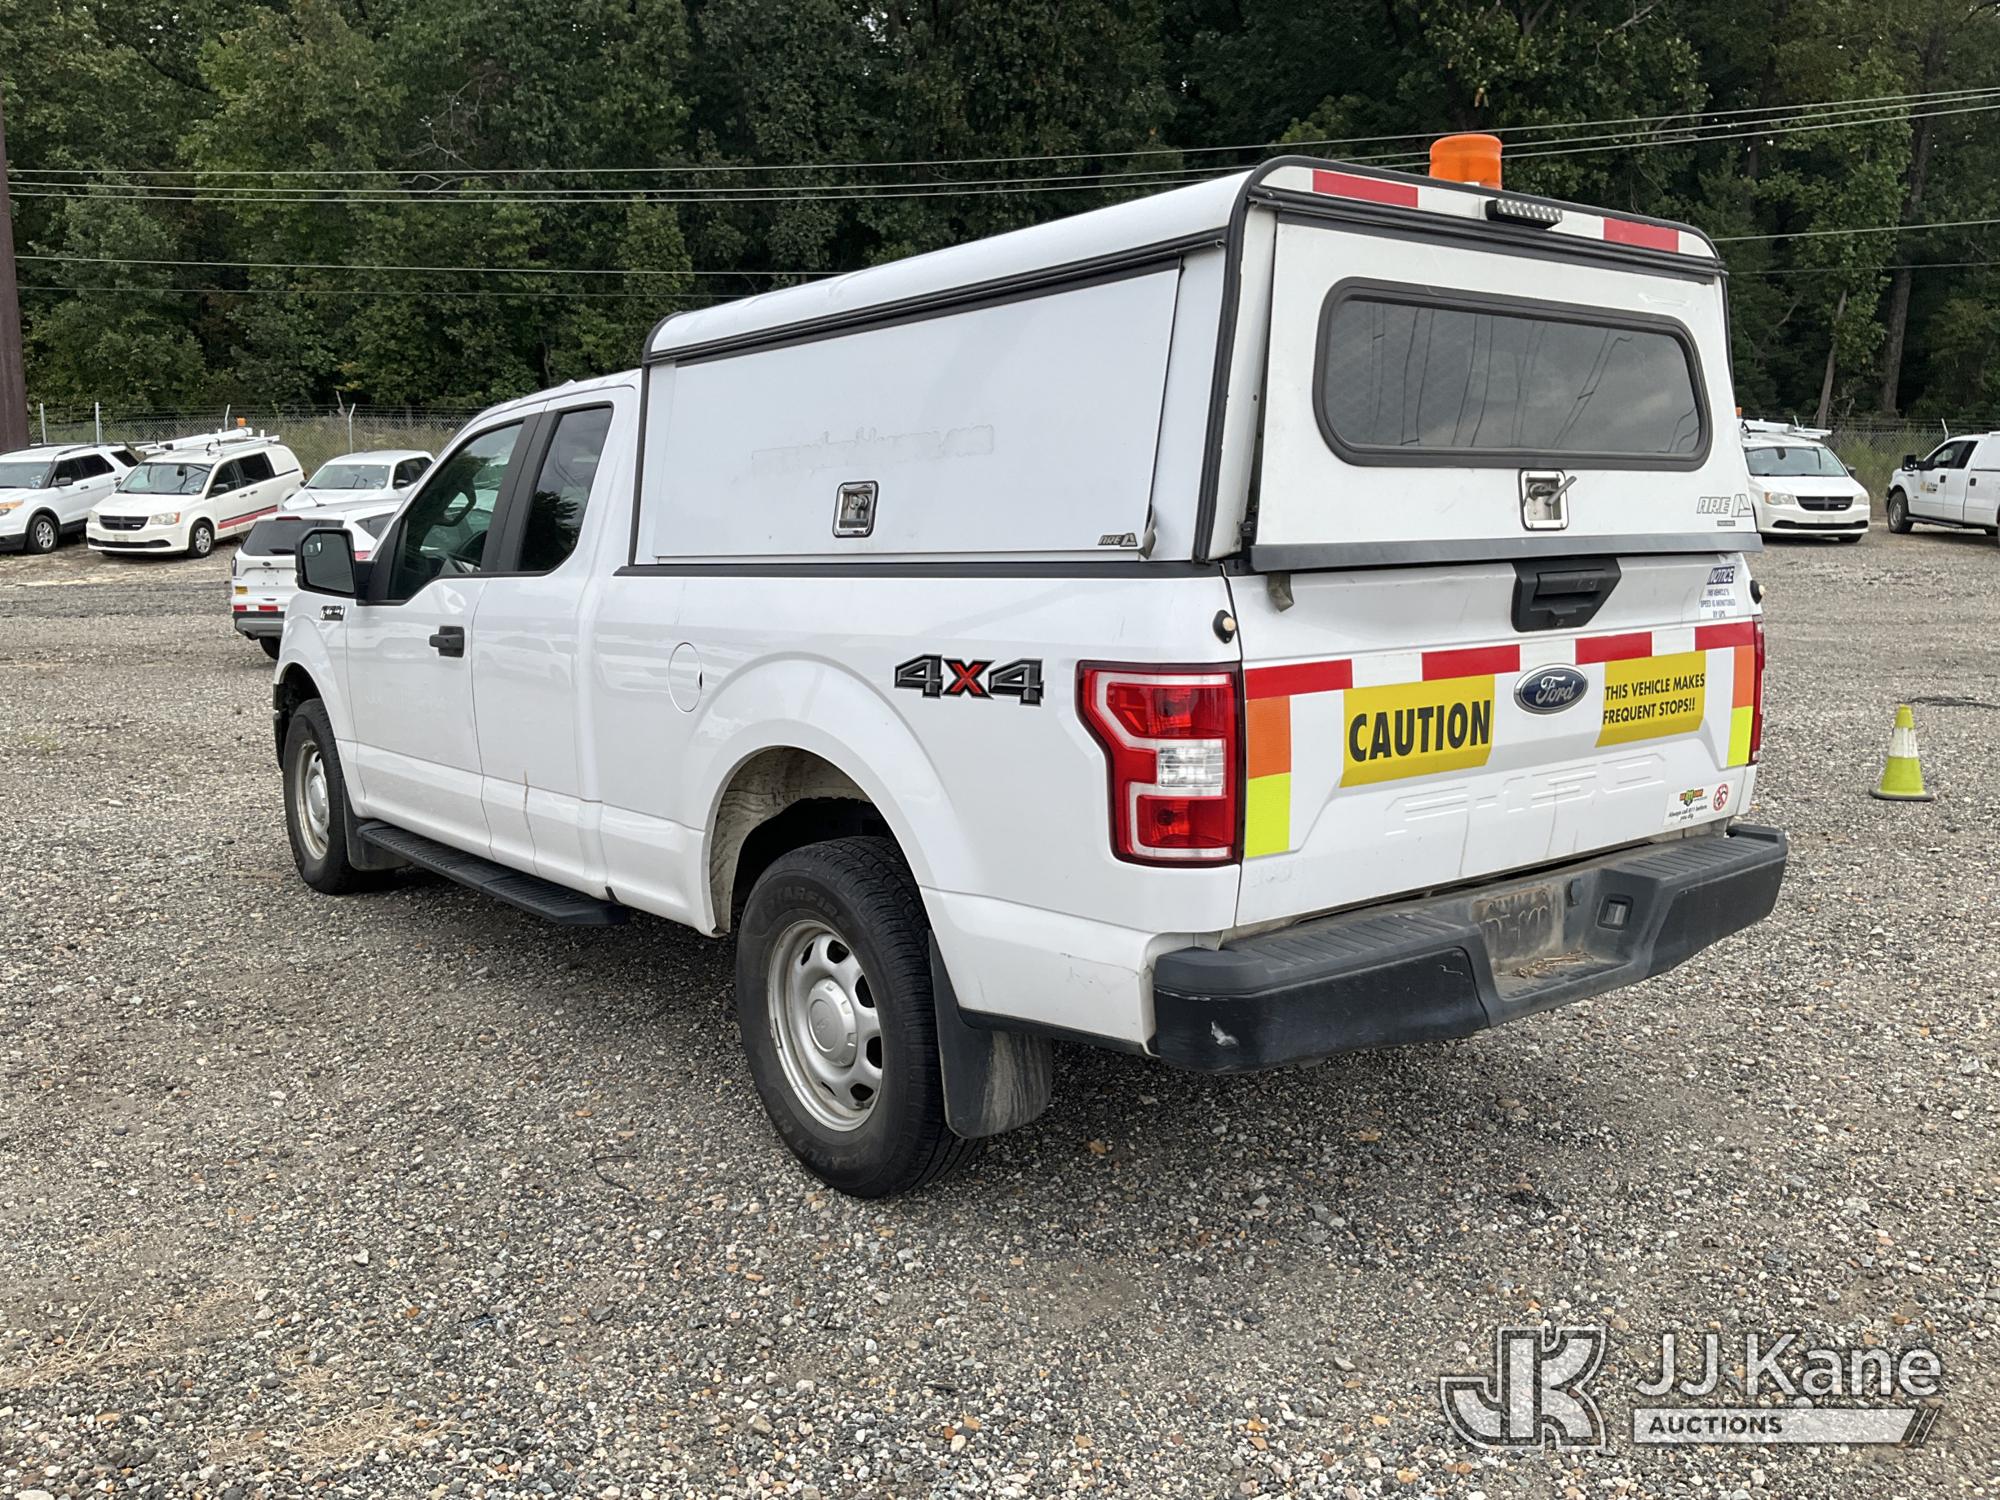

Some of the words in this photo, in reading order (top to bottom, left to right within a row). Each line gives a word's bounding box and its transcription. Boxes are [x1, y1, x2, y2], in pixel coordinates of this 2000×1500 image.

[1711, 568, 1734, 583] NOTICE
[1536, 675, 1575, 704] Ford
[1605, 684, 1628, 700] THIS
[1632, 678, 1670, 696] VEHICLE
[1673, 673, 1705, 692] MAKES
[1603, 703, 1656, 725] FREQUENT
[1659, 697, 1695, 716] STOPS!!
[1350, 700, 1491, 762] CAUTION
